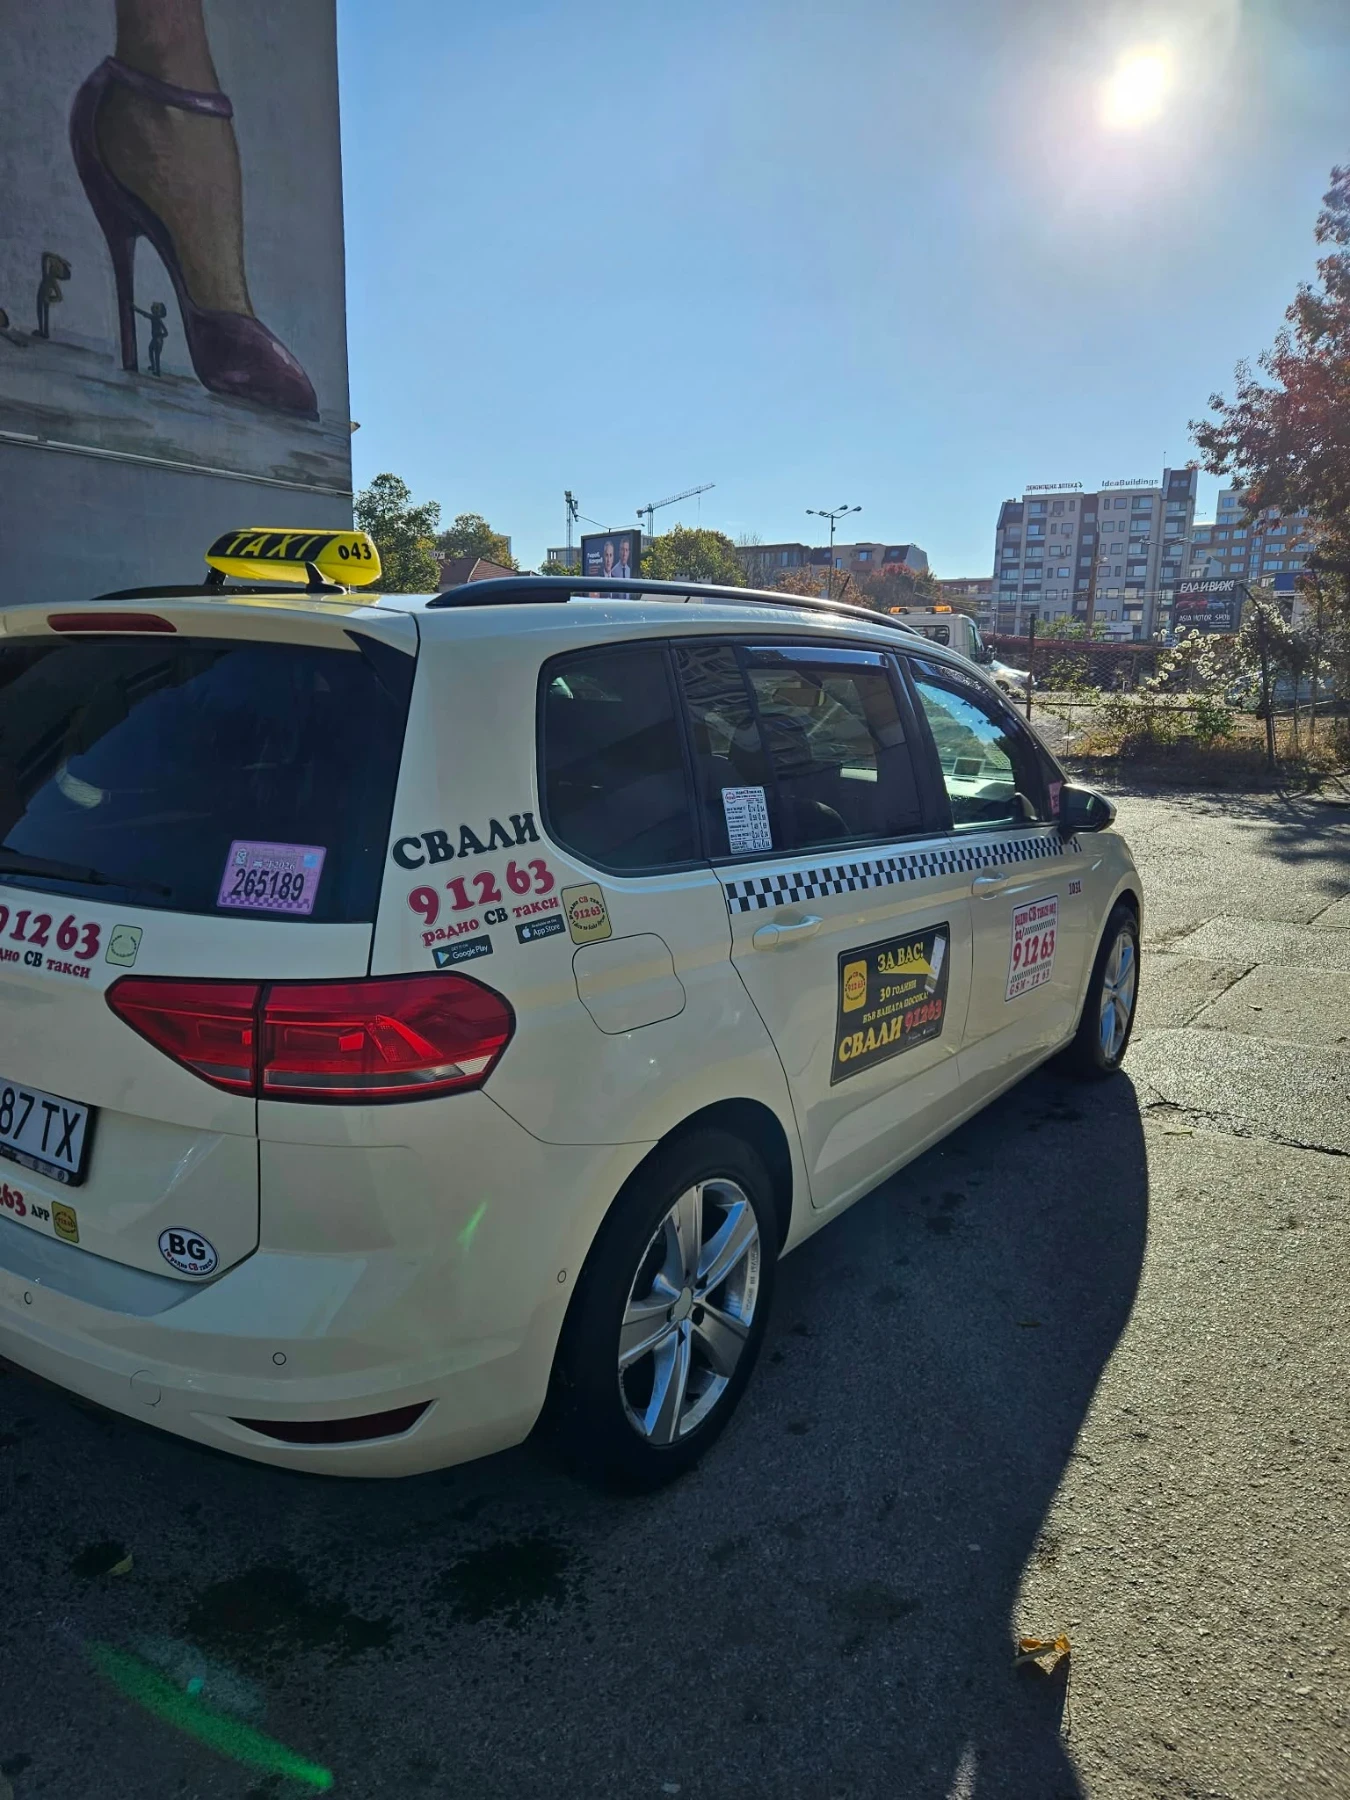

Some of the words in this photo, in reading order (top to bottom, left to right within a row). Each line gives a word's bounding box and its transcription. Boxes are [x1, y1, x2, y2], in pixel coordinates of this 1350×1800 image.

[1102, 478, 1158, 488] IdeaBuildings
[226, 534, 320, 558] TAXI
[338, 542, 372, 560] 043
[1180, 582, 1200, 592] ЕЛА
[1200, 582, 1211, 592] И
[1193, 613, 1212, 621] MOTOR
[392, 812, 540, 870] СВАЛИ
[231, 868, 304, 900] 265189
[422, 918, 479, 946] радио
[484, 908, 508, 925] СВ
[513, 897, 560, 918] такси
[533, 928, 545, 937] App
[546, 924, 560, 932] Store
[453, 948, 476, 959] Google
[475, 945, 487, 953] Play
[877, 950, 895, 972] ЗА
[897, 942, 924, 966] ВАС!
[24, 950, 43, 967] СВ
[46, 959, 91, 979] такси
[880, 987, 891, 1002] 30
[892, 979, 916, 997] ГОДИНИ
[1009, 981, 1025, 995] GSM
[862, 1012, 876, 1023] ВЪВ
[876, 1002, 903, 1019] ВАШАТА
[839, 1015, 903, 1062] СВАЛИ
[904, 1000, 942, 1033] 91263
[0, 1087, 35, 1140] 87
[41, 1100, 81, 1163] TX
[0, 1183, 26, 1216] 63
[31, 1204, 50, 1221] APP
[169, 1232, 205, 1260] BG
[188, 1263, 198, 1271] СВ
